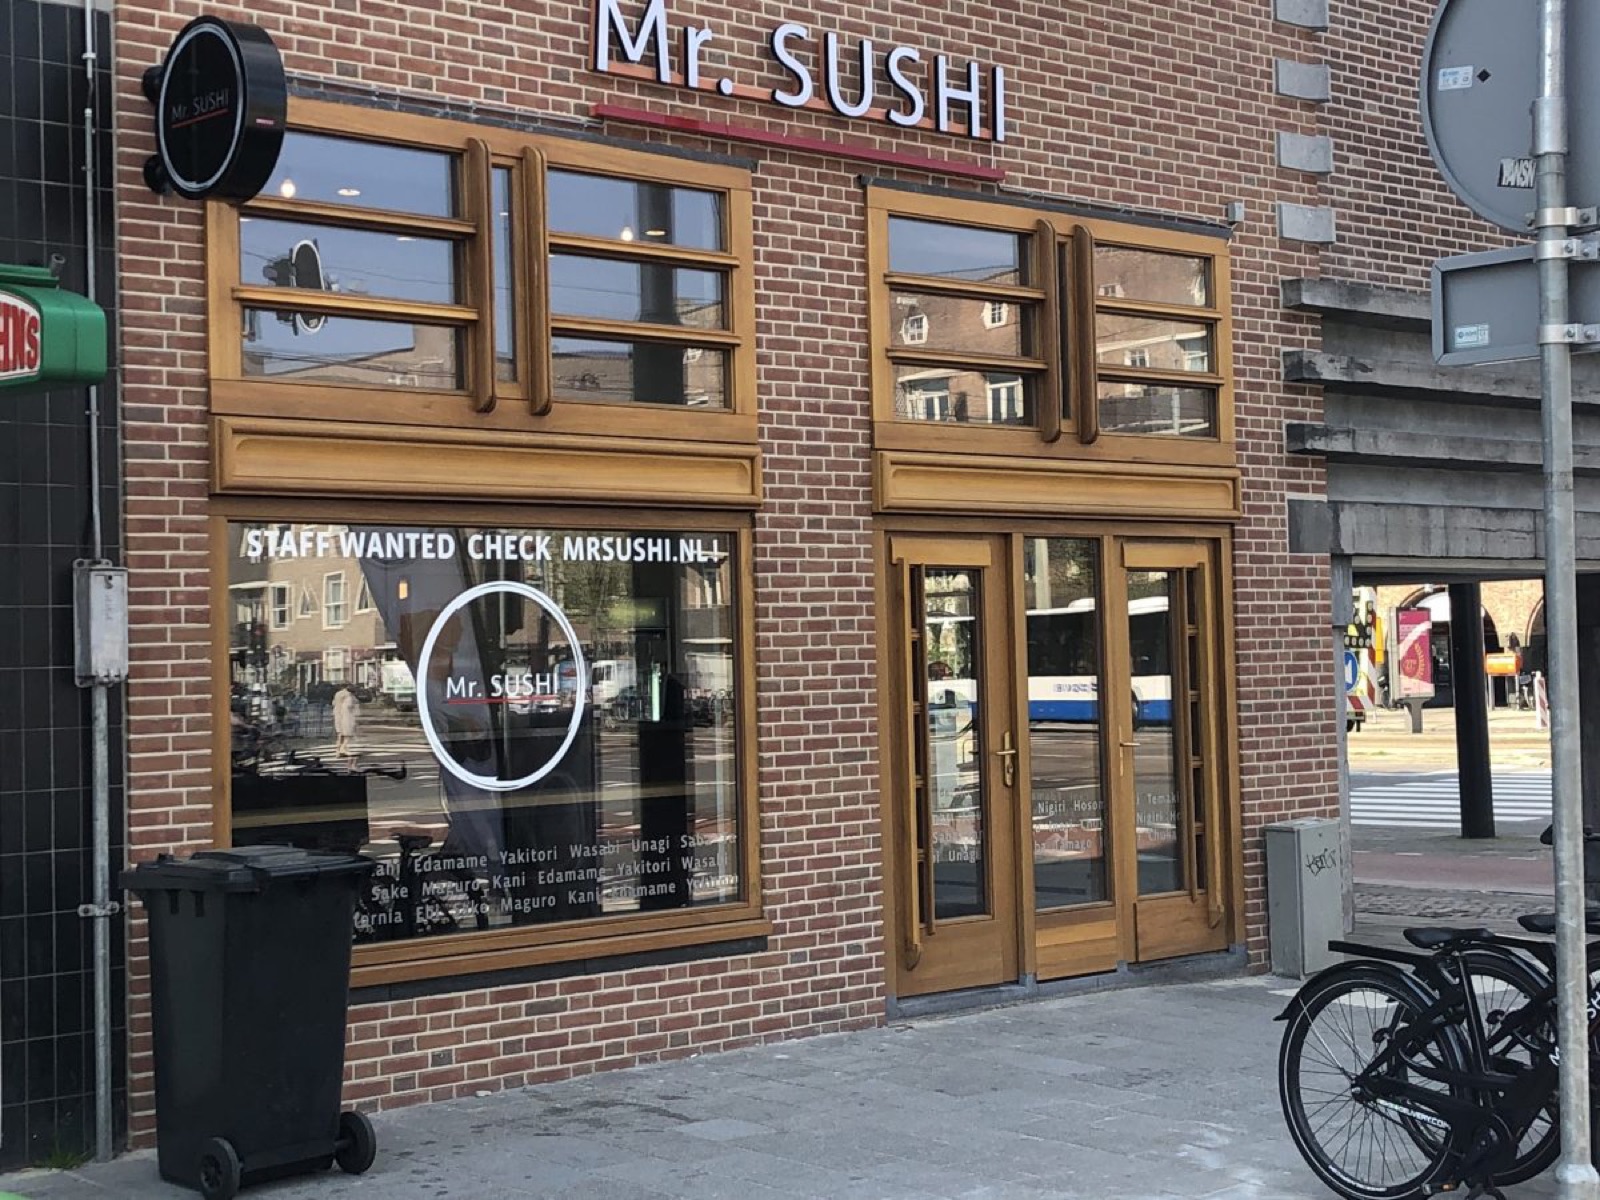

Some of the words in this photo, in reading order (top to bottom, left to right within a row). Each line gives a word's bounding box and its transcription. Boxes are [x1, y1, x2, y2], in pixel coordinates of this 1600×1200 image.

[594, 0, 733, 95] Mr.
[771, 23, 1005, 141] SUSHI
[193, 87, 229, 116] SUSHI
[247, 530, 330, 557] STAFF
[339, 531, 456, 559] WANTED
[467, 534, 552, 561] CHECK
[447, 676, 482, 698] Mr.
[490, 672, 558, 697] SUSHI
[1038, 799, 1066, 816] Nigiri
[414, 855, 488, 873] Edamame
[500, 846, 557, 865] Yakitori
[570, 840, 620, 858] Wasabi
[631, 835, 670, 854] Unagi
[371, 883, 409, 901] Sake
[422, 878, 480, 897] Maguro
[492, 872, 526, 889] Kani
[538, 867, 606, 885] Edamame
[617, 857, 670, 877] Yakitori
[500, 895, 556, 913] Maguro
[568, 886, 600, 905] Kani
